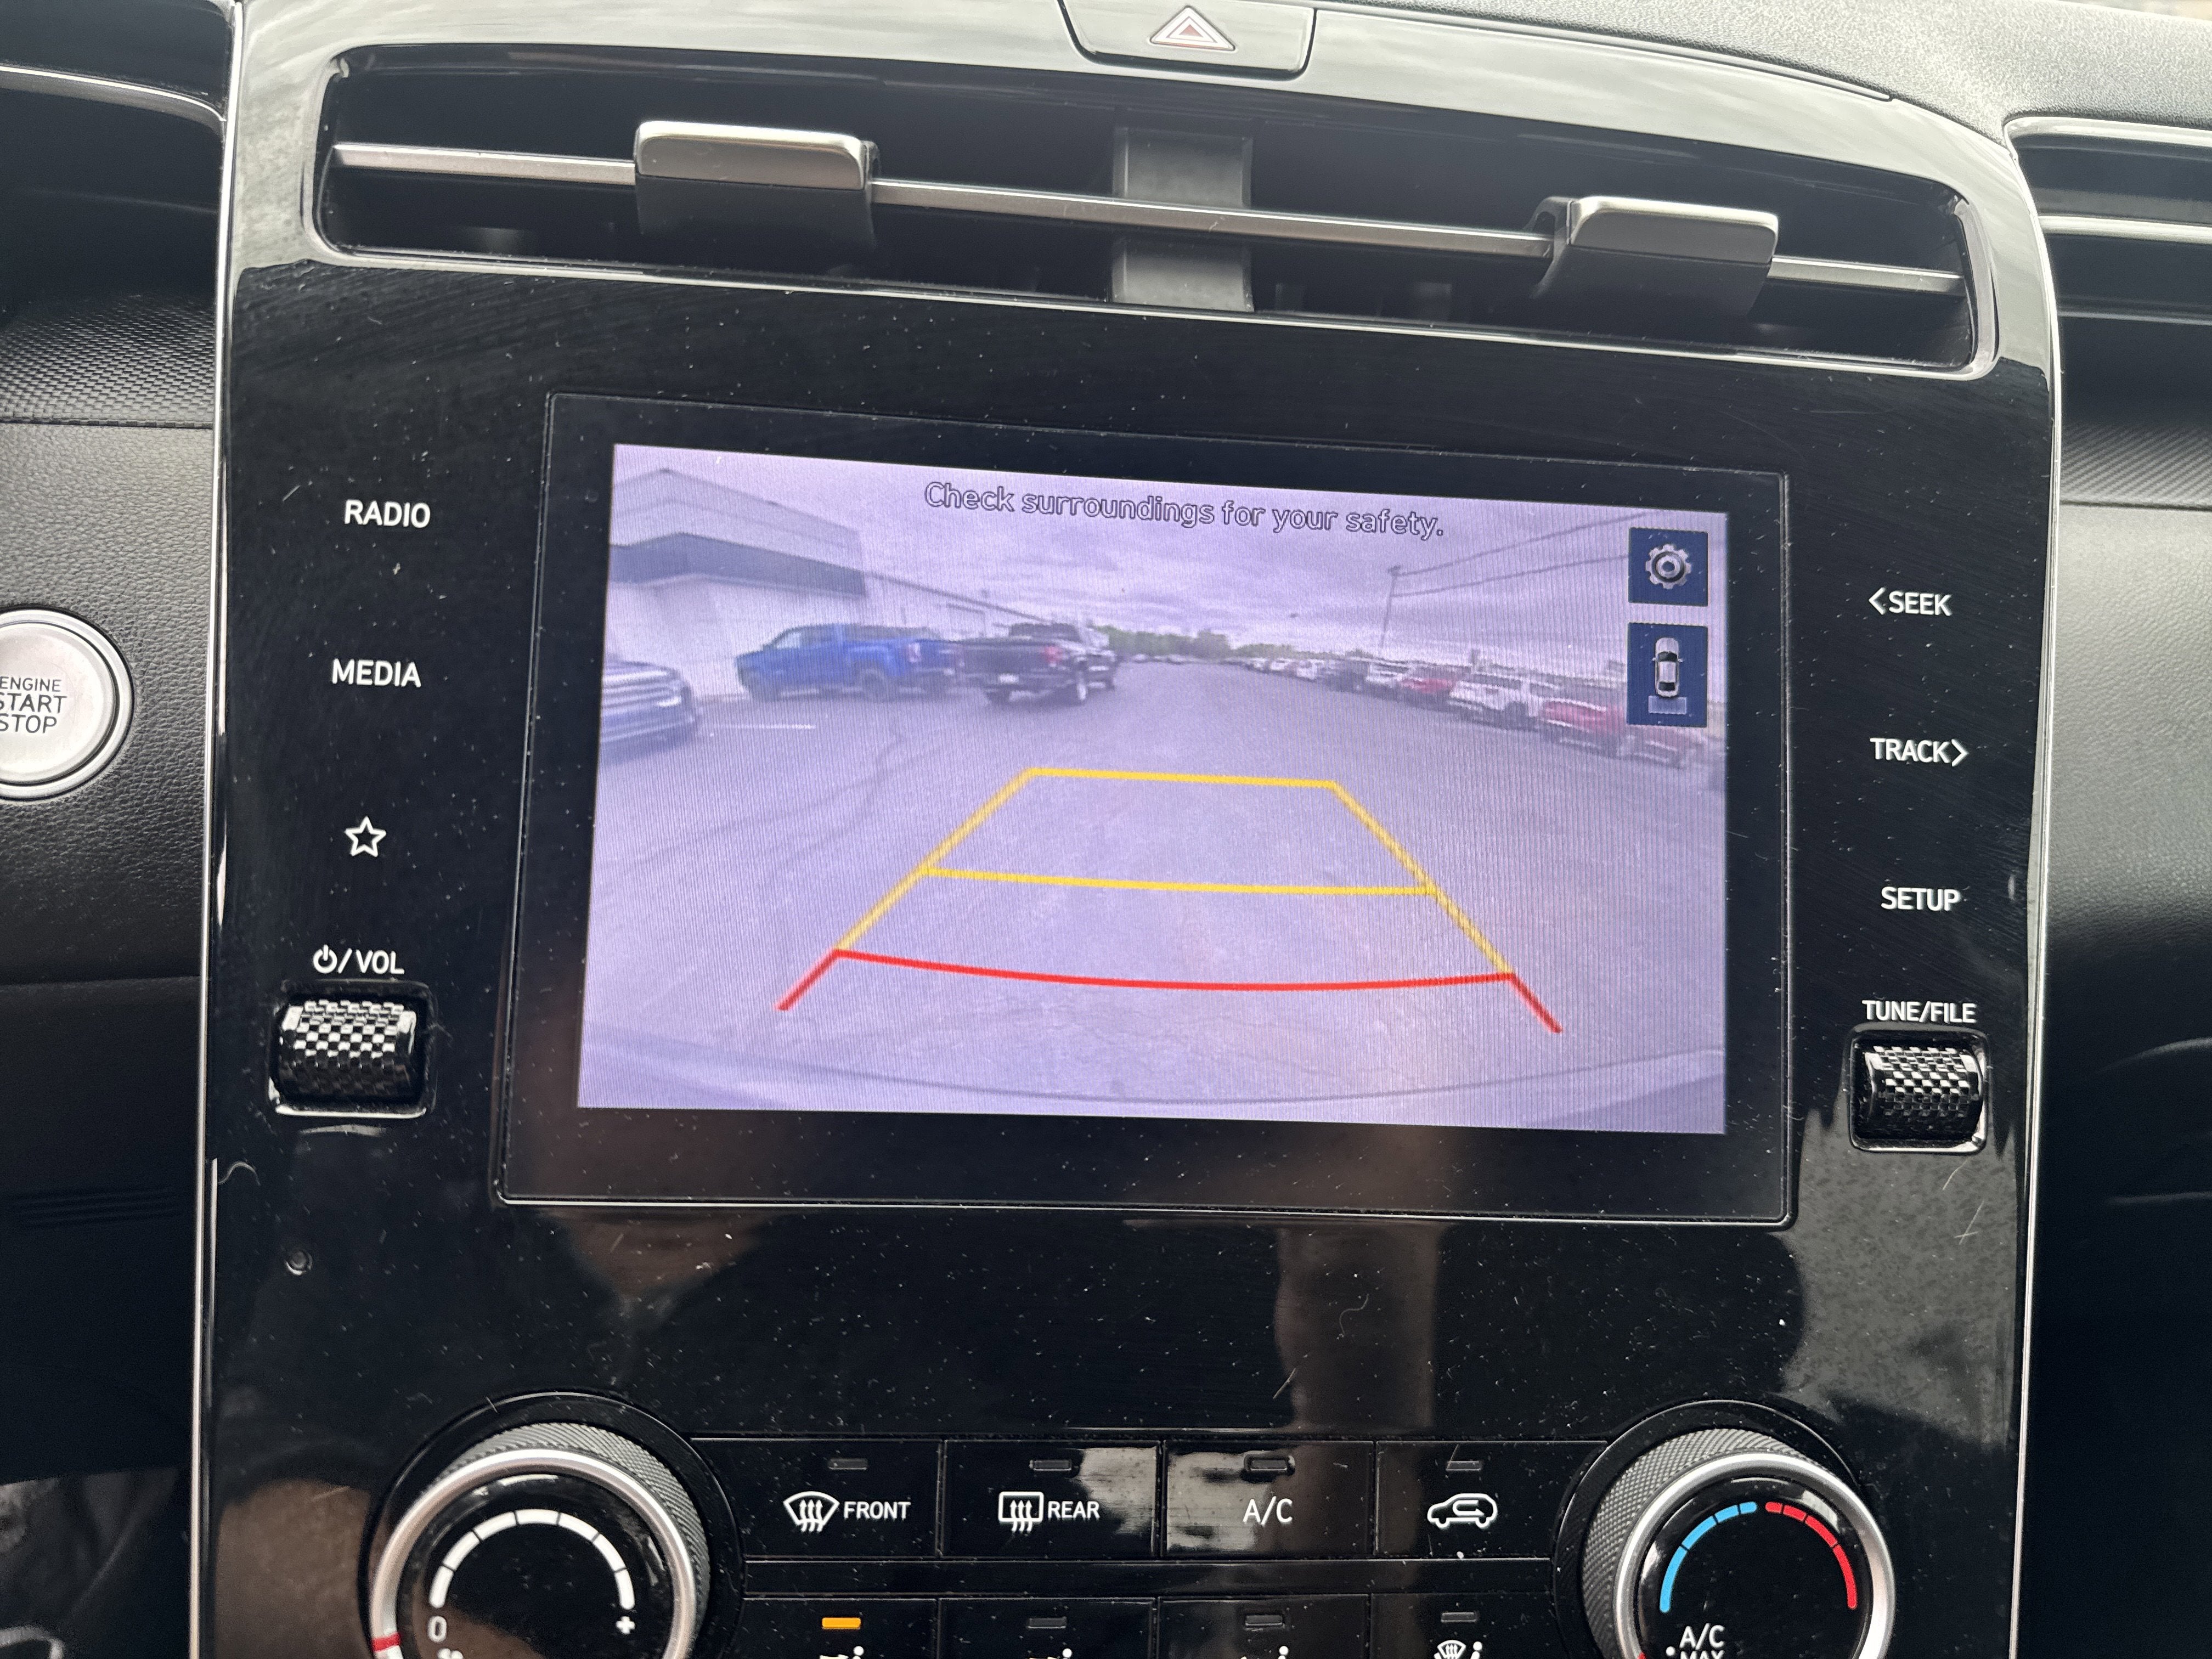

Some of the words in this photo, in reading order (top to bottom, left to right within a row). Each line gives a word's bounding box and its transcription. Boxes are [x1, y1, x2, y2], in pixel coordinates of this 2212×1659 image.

[344, 499, 431, 528] RADIO
[925, 482, 1014, 512] Check
[1022, 493, 1215, 528] surroundings
[1222, 500, 1265, 526] for
[1273, 508, 1338, 533] your
[1345, 508, 1444, 541] safety.
[0, 676, 61, 692] ENGINE
[331, 658, 421, 687] MEDIA
[1881, 886, 1962, 911] SETUP
[1861, 1000, 1977, 1024] TUNE/FILE
[844, 1501, 911, 1520] FRONT
[1047, 1500, 1101, 1520] REAR
[1243, 1496, 1294, 1525] A/C
[1679, 1623, 1725, 1650] A/C
